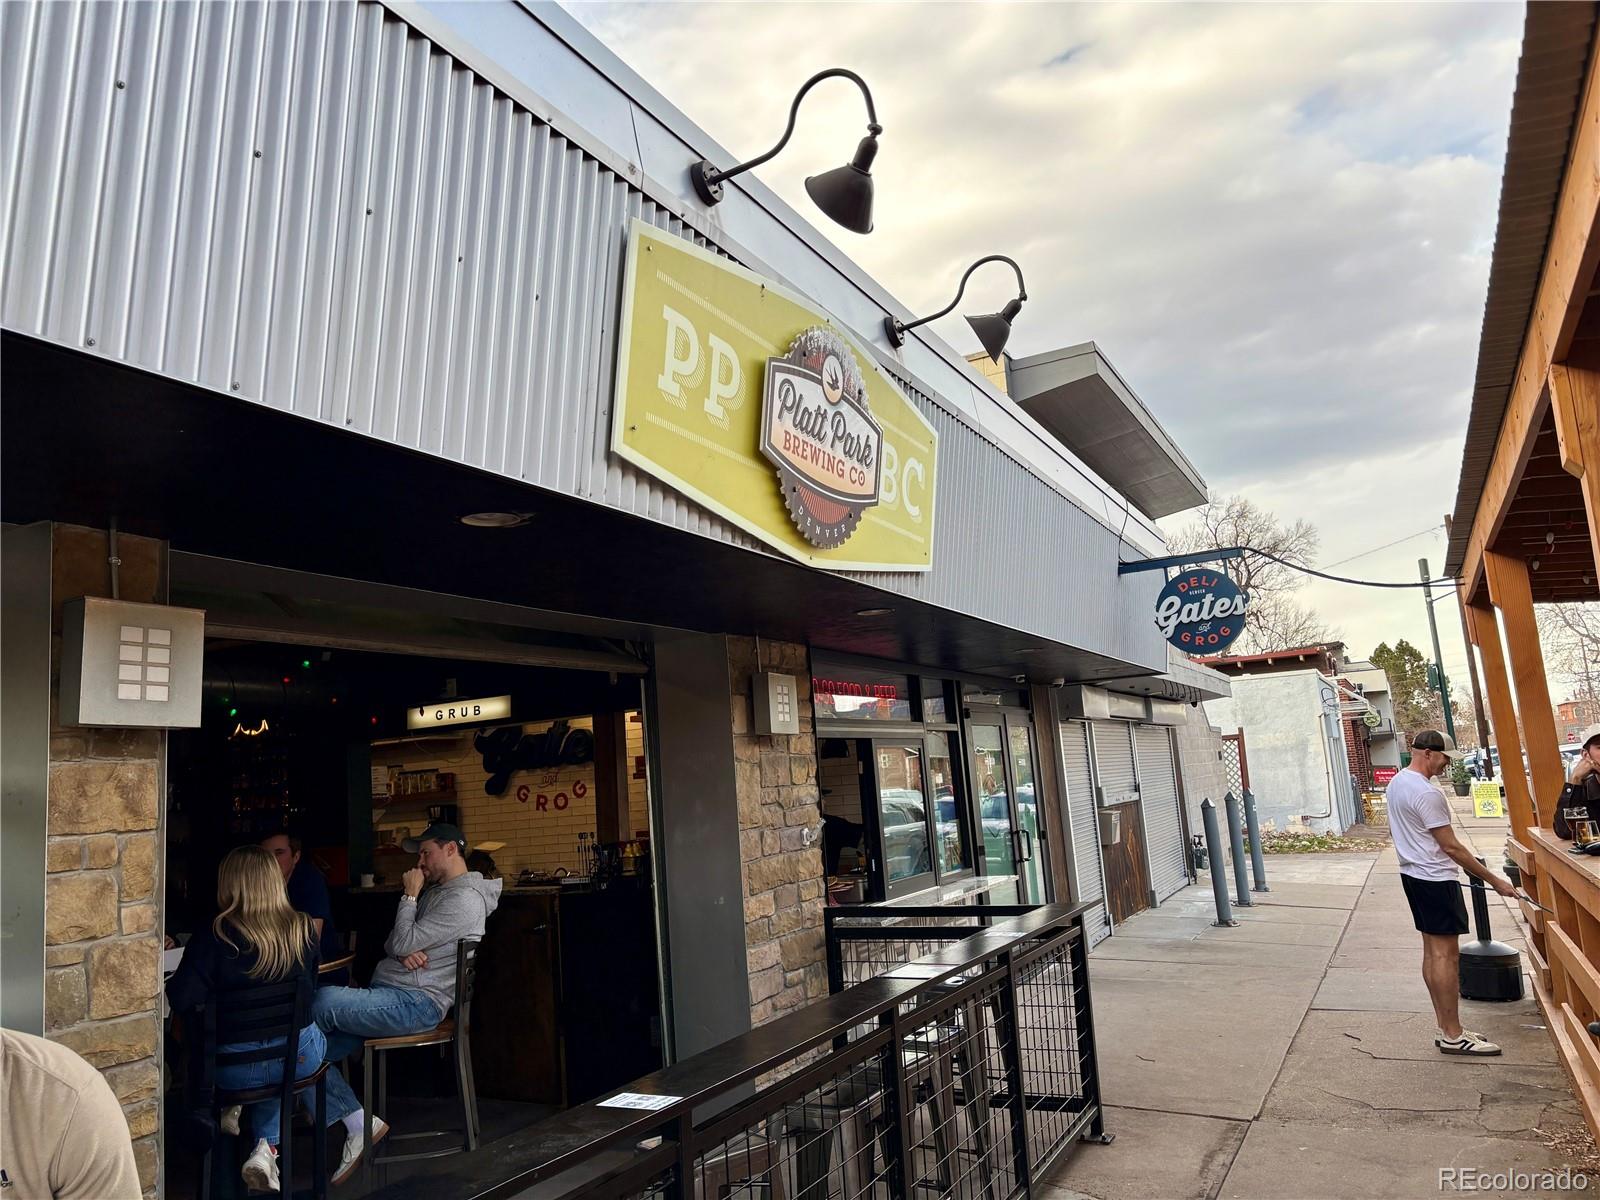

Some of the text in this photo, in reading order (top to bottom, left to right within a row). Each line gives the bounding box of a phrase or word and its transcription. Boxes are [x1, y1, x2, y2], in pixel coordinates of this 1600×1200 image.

[657, 304, 927, 522] PP BC
[778, 377, 874, 470] Platt Park
[782, 430, 866, 487] BREWING CO
[798, 505, 848, 538] DENVER
[1177, 575, 1218, 592] DELI
[1155, 593, 1247, 638] Gates
[1181, 626, 1231, 645] GROG
[435, 704, 482, 721] GRUB
[516, 779, 588, 812] GROG
